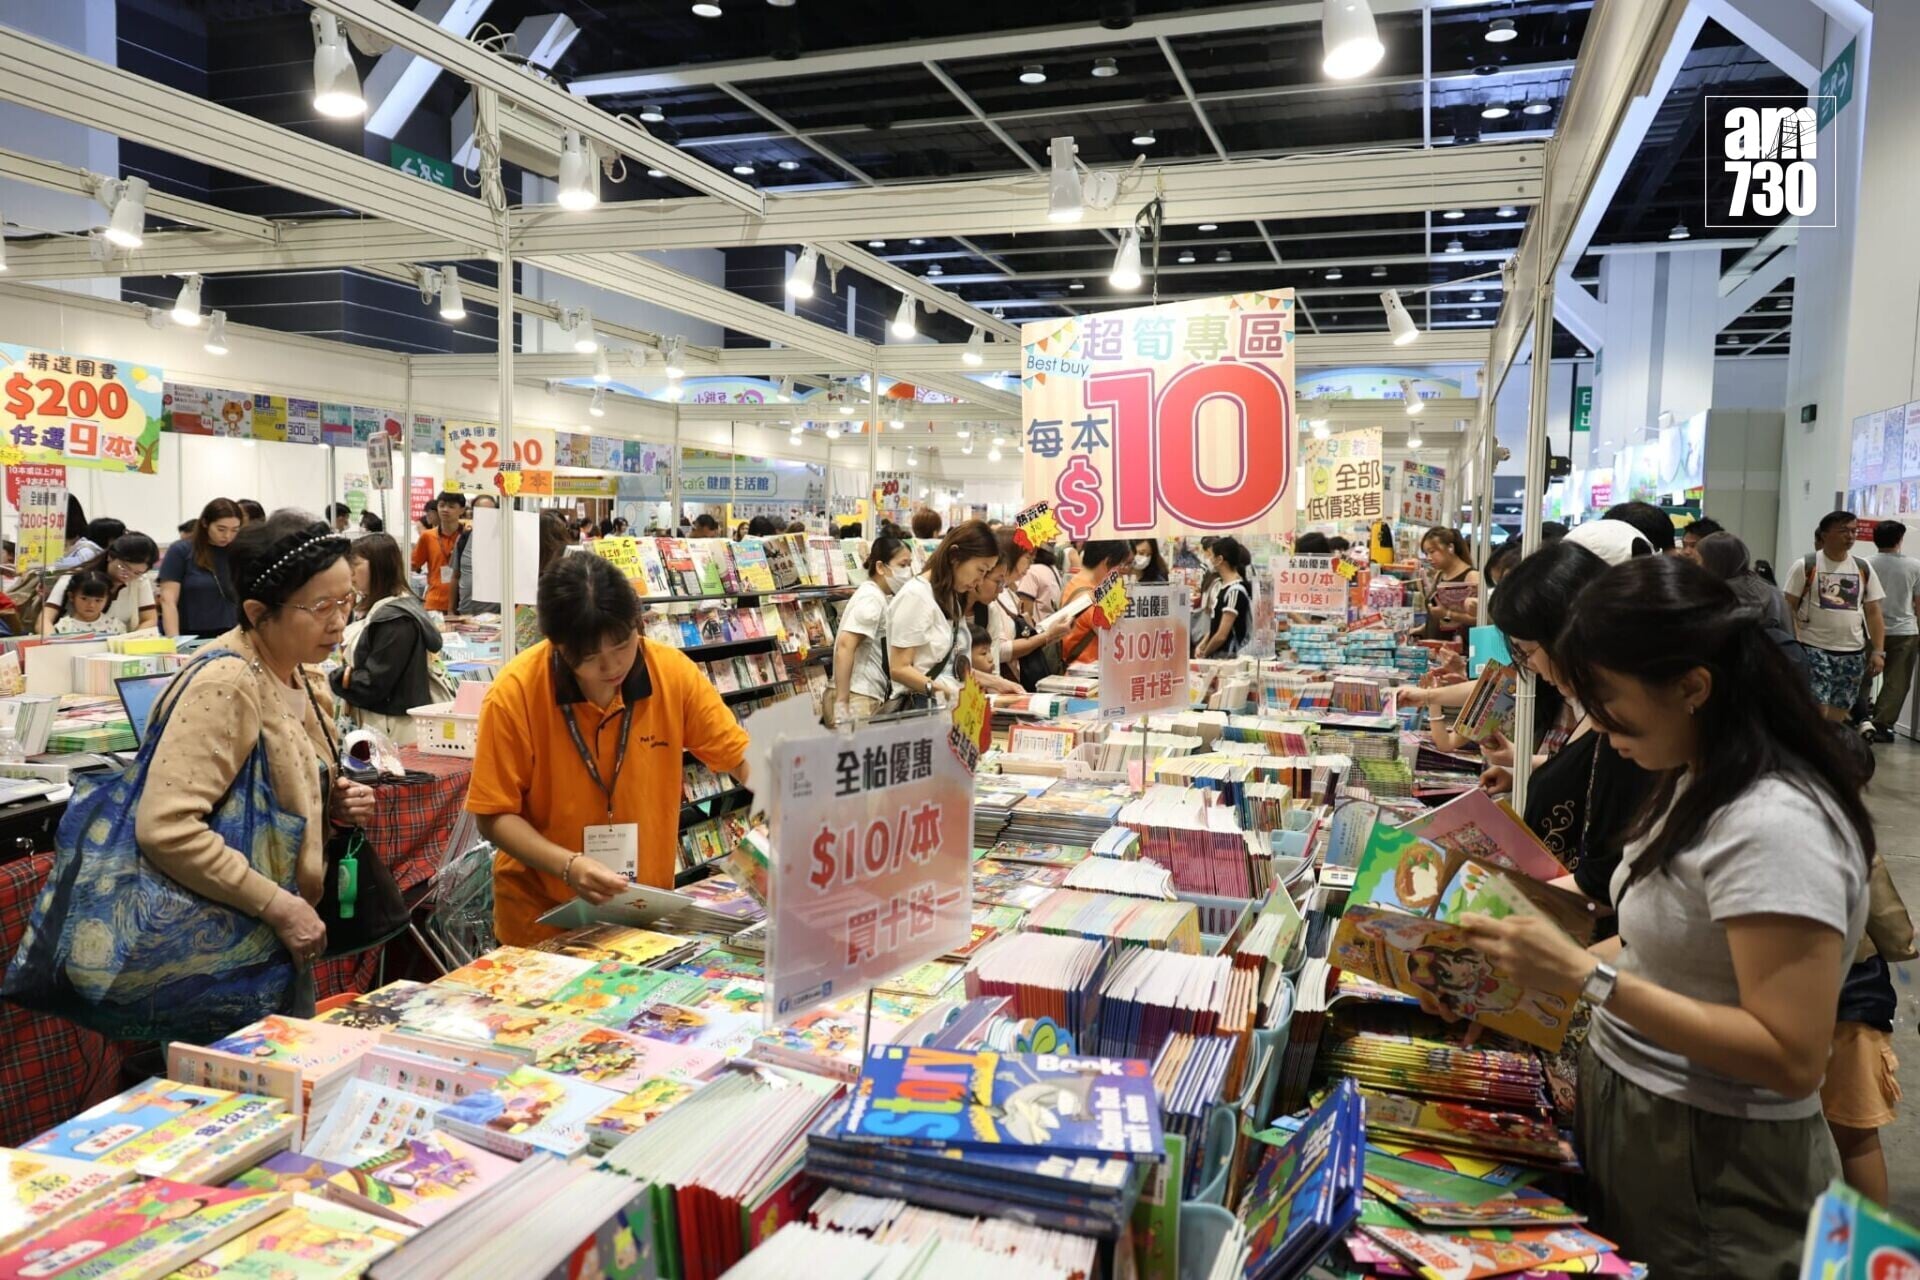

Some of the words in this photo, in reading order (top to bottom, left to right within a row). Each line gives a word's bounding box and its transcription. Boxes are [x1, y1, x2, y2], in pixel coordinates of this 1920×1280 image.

[1080, 312, 1287, 361] 超筍專區
[28, 352, 118, 380] 精選圖書
[1026, 355, 1058, 373] Best
[1060, 358, 1090, 377] buy
[5, 372, 129, 420] $200
[1027, 414, 1110, 458] 每本
[1056, 357, 1290, 541] $10
[707, 475, 769, 491] 健康生活館
[1335, 459, 1381, 492] 全部
[1307, 492, 1381, 521] 低價發售
[1280, 571, 1335, 587] $10/本
[1113, 630, 1175, 662] $10/本
[1130, 671, 1184, 702] 買十送一
[835, 738, 934, 798] 全枱優惠
[810, 803, 943, 891] $10/本
[847, 887, 962, 966] 買十送一
[1036, 1055, 1123, 1077] Book
[1124, 1058, 1148, 1078] 3
[863, 1046, 993, 1140] Story
